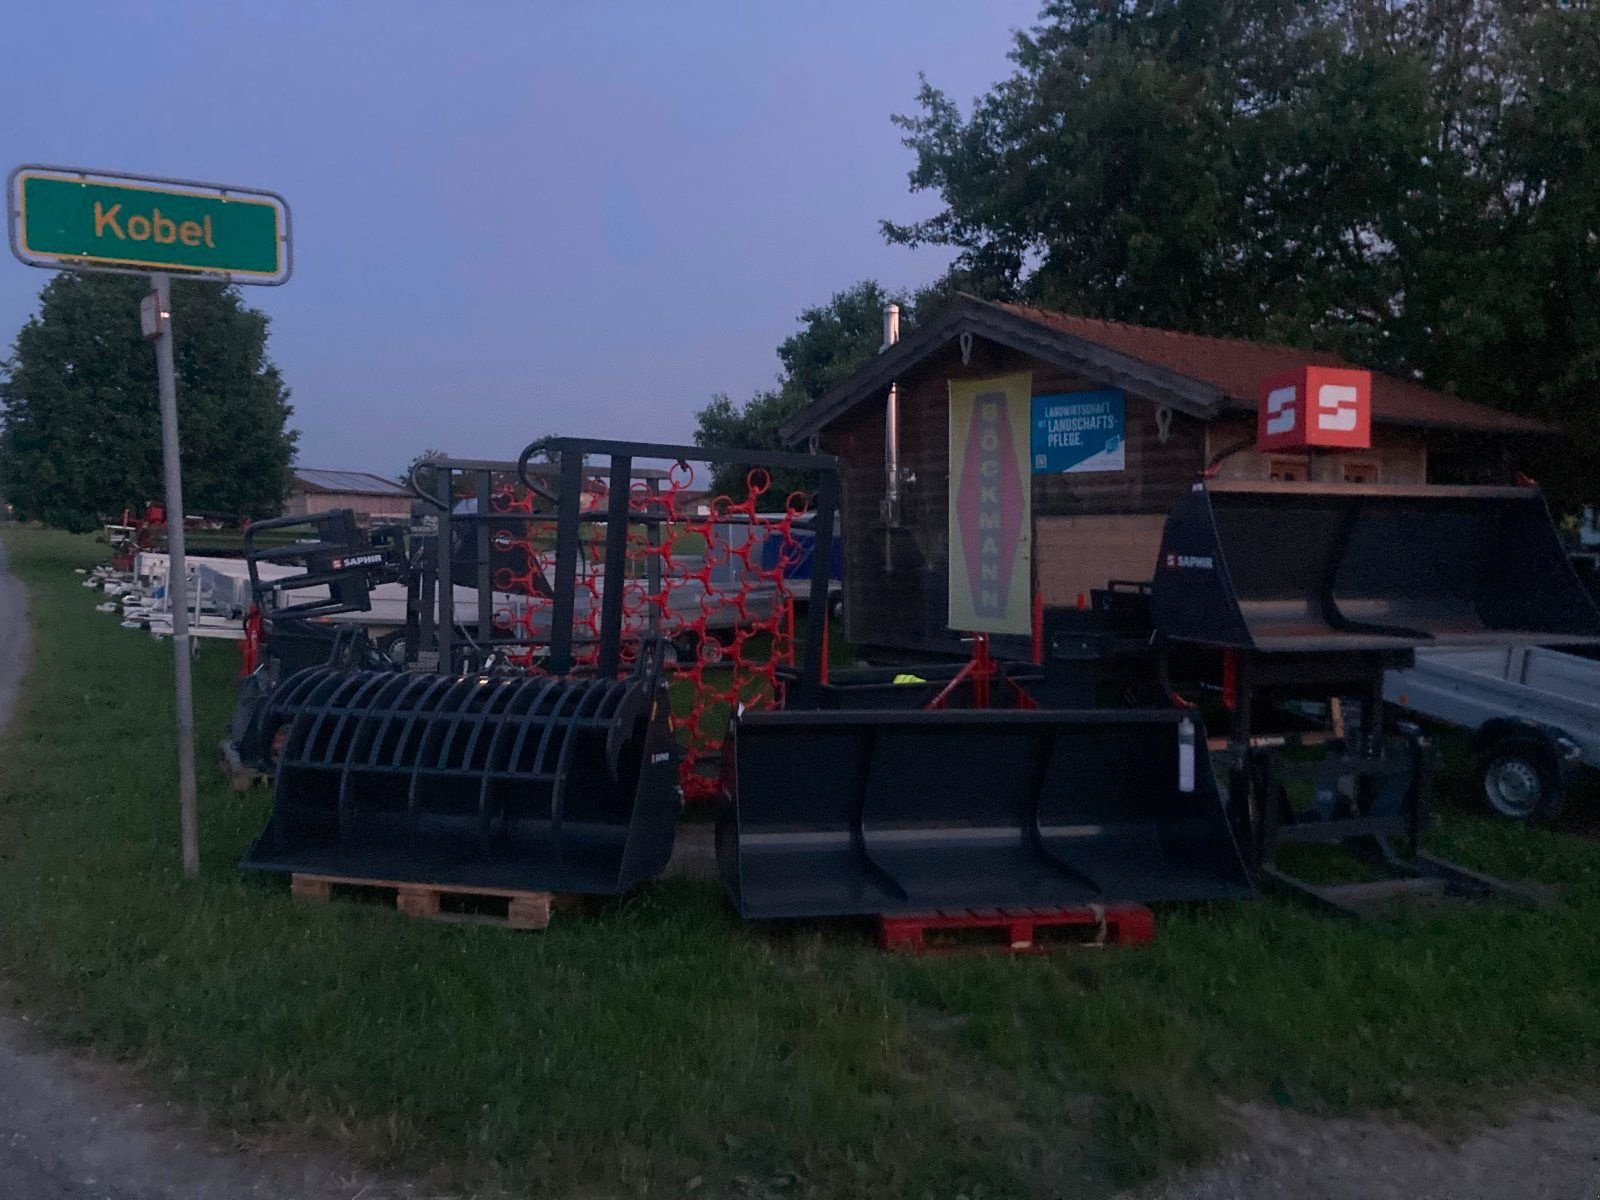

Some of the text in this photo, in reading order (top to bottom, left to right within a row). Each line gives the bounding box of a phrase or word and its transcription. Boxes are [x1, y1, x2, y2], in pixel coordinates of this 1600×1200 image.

[93, 200, 215, 249] Kobel
[1048, 414, 1118, 432] LANDSCHAFTS-
[343, 554, 382, 567] SAPHIR
[1177, 555, 1213, 569] SAPHIR
